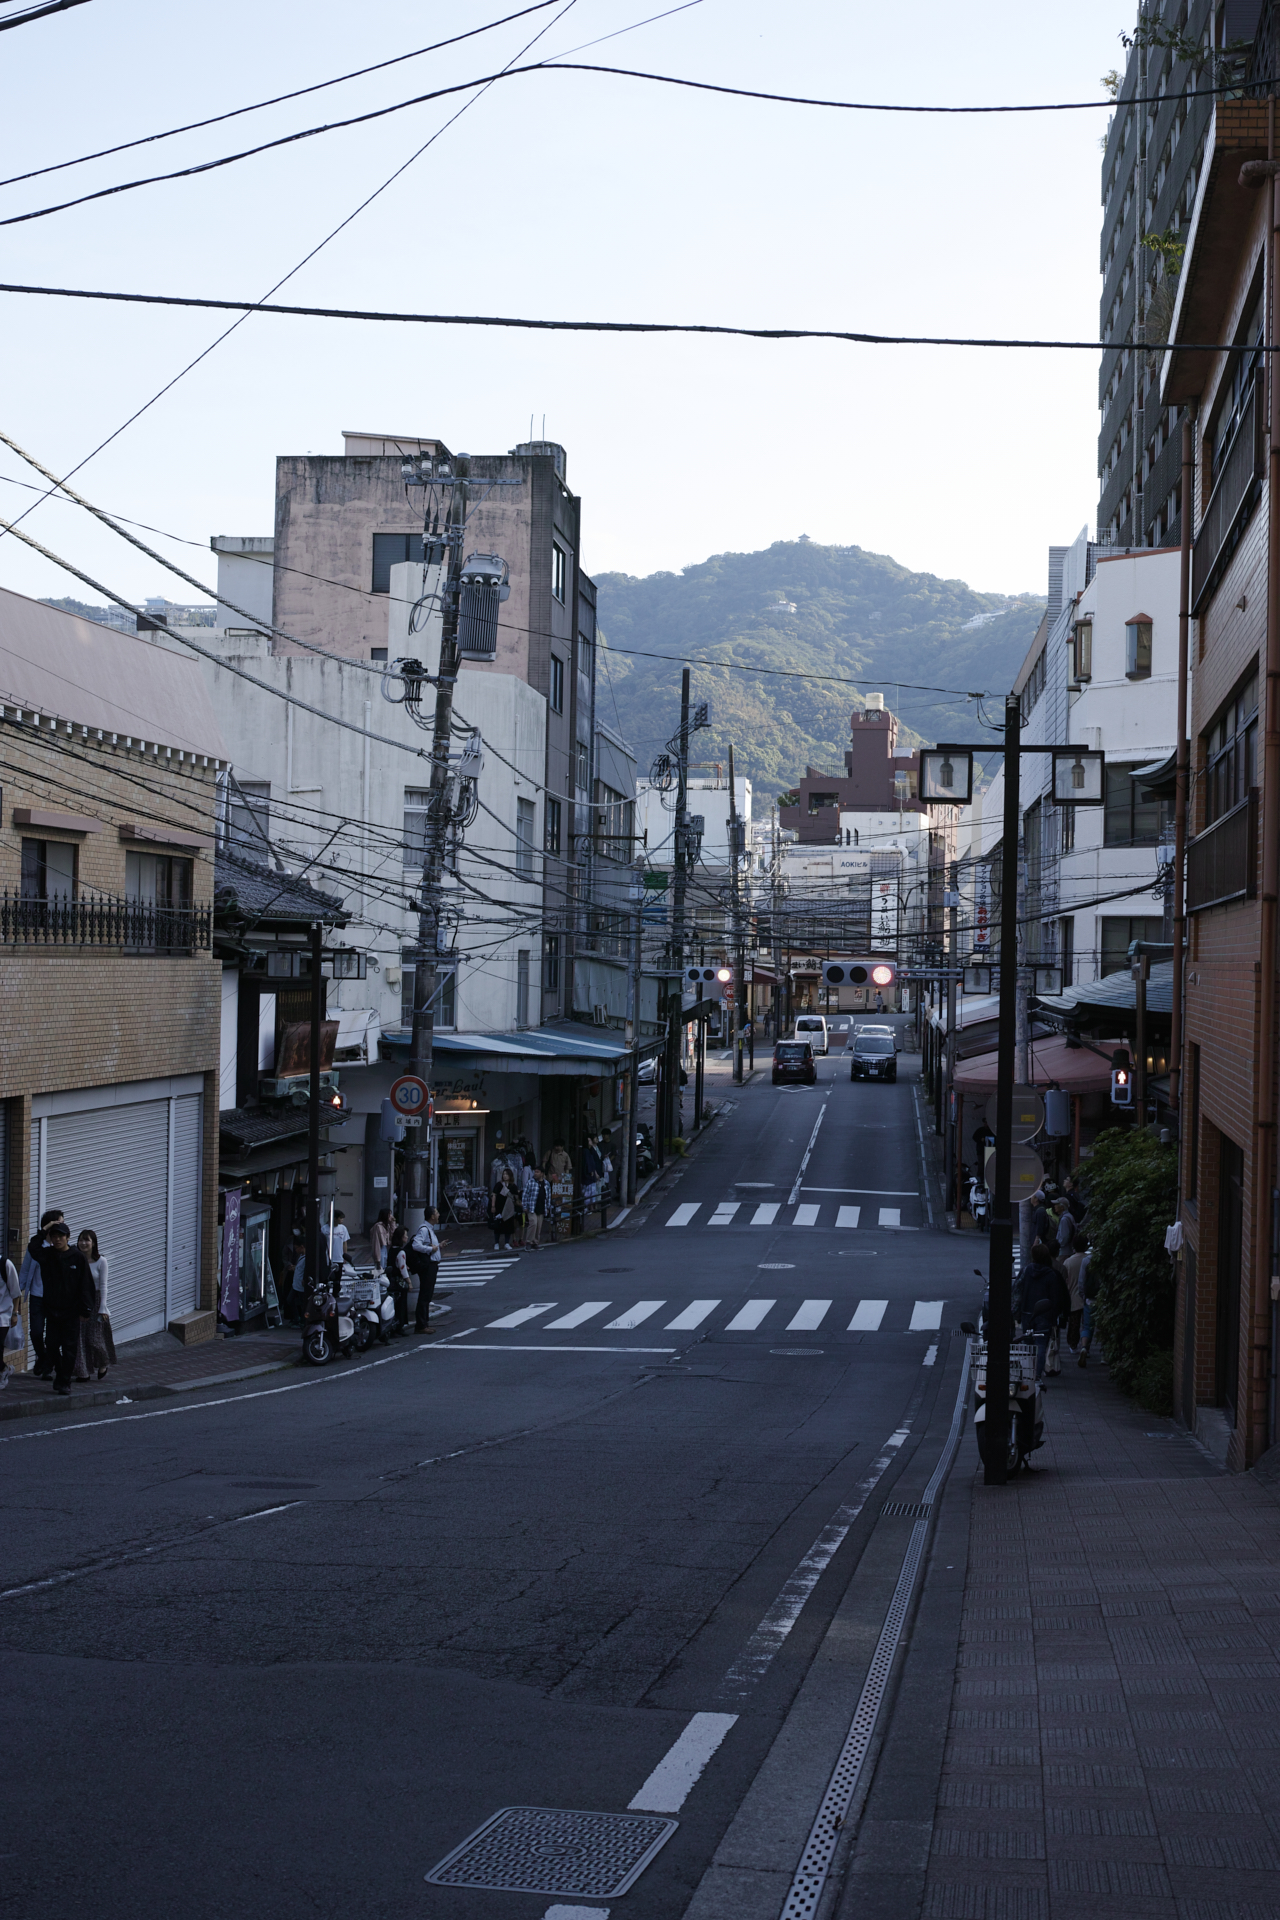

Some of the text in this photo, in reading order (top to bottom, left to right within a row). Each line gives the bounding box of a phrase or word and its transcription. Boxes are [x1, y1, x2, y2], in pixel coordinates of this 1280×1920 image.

[452, 1077, 484, 1094] Laut
[399, 1087, 420, 1104] 30
[396, 1117, 420, 1126] 区域内
[435, 1114, 460, 1126] 験工房
